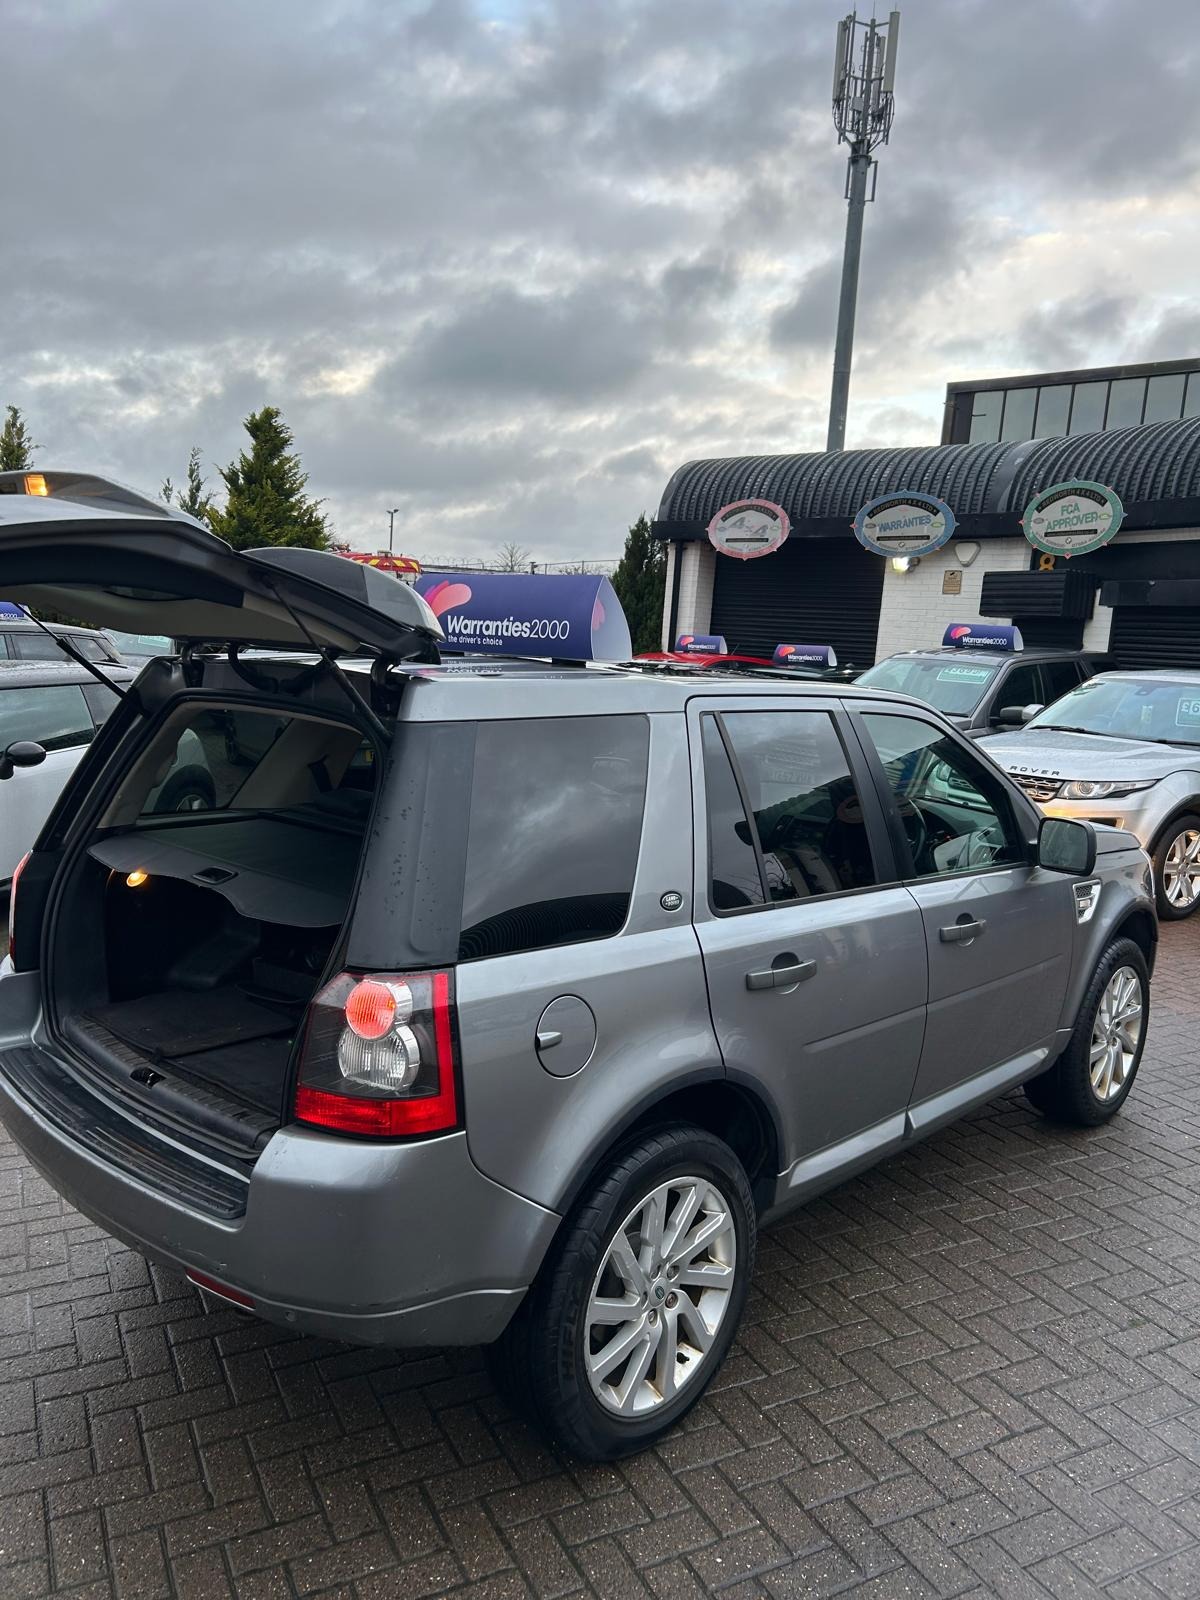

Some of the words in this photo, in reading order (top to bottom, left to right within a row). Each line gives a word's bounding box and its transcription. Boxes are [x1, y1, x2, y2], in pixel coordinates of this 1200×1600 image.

[1061, 503, 1080, 516] FCA
[878, 515, 932, 533] WARRANTIES
[447, 615, 570, 640] Warranties2000
[448, 635, 457, 643] the
[459, 635, 482, 645] driver's
[482, 637, 503, 646] choice
[1009, 765, 1060, 776] ROVER
